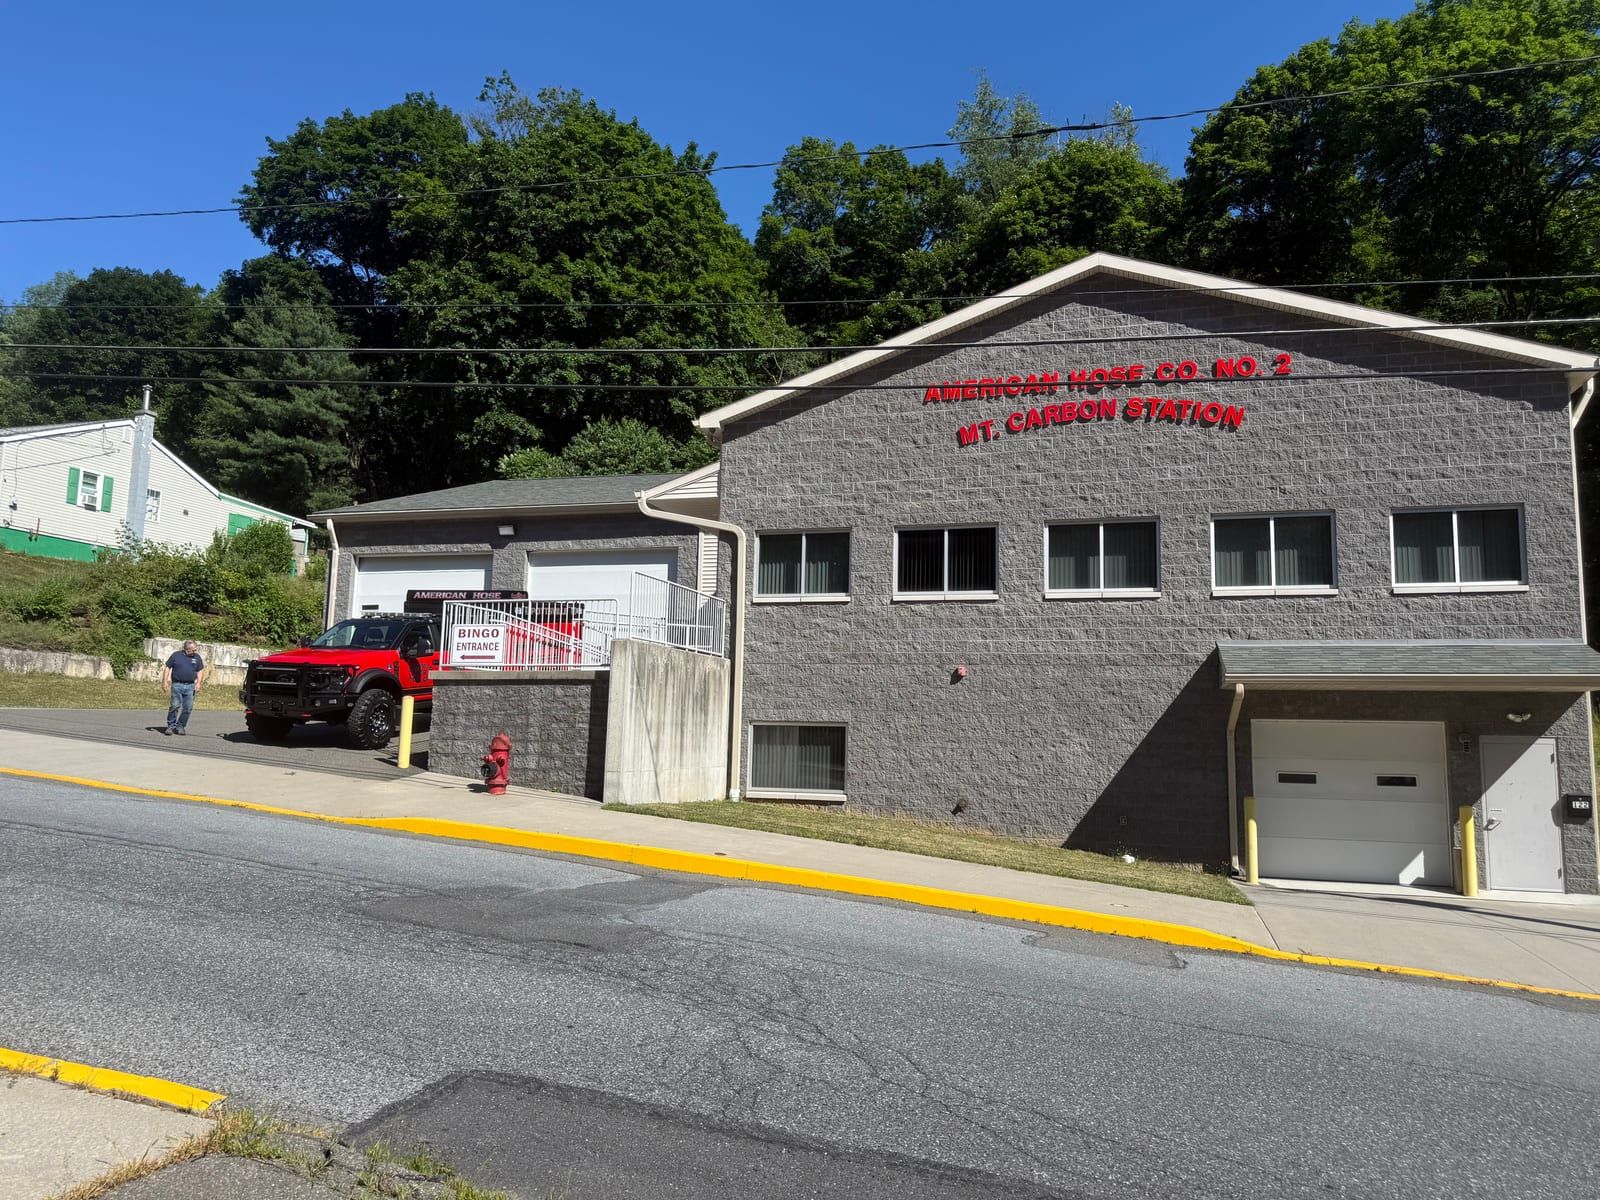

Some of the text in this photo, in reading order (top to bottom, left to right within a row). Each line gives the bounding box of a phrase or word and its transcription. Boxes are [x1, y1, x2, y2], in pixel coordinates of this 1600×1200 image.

[924, 369, 1059, 401] AMERICAN
[1069, 364, 1145, 391] HOSE
[1216, 355, 1264, 379] NO.
[1275, 352, 1292, 375] 2
[959, 397, 1245, 446] MT. CARBON STATION
[413, 591, 467, 599] AMERICAN
[472, 591, 502, 599] HOSE
[458, 628, 500, 638] BINGO
[456, 642, 500, 651] ENTRANCE
